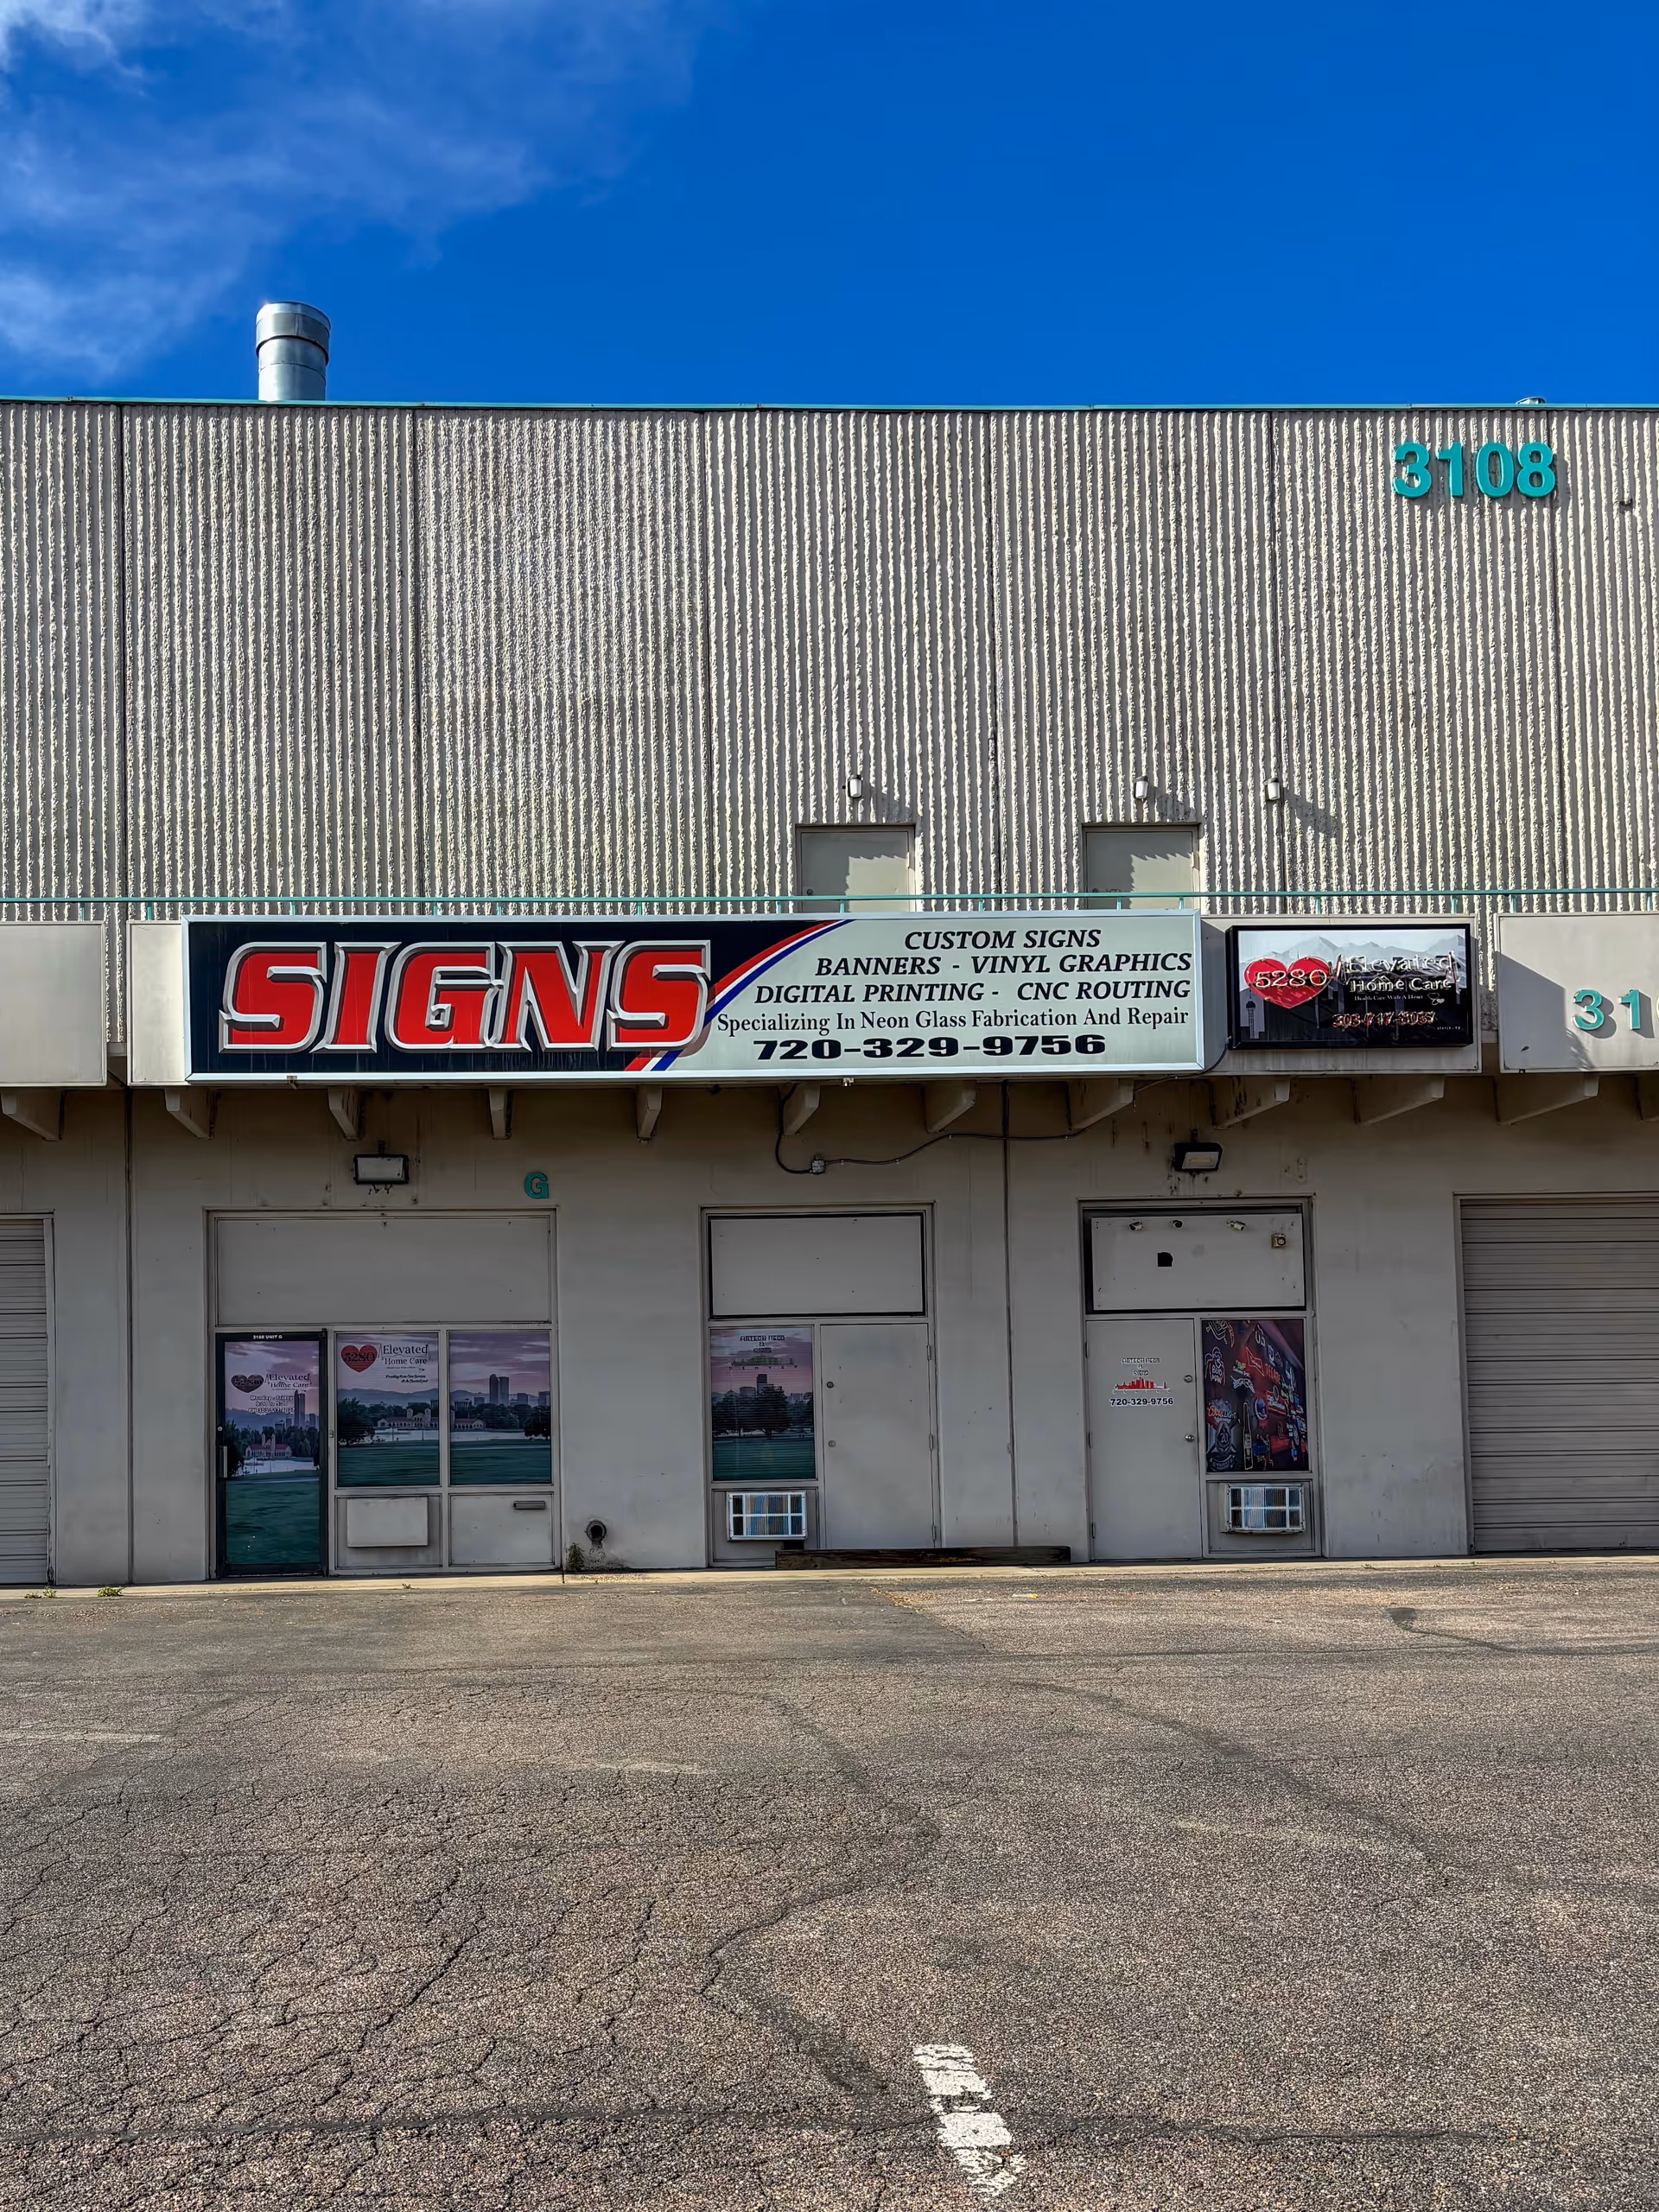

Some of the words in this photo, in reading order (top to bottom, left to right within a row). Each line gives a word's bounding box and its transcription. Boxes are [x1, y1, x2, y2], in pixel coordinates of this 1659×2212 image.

[1393, 442, 1556, 499] 3108
[905, 930, 1016, 951] CUSTOM
[1022, 928, 1102, 949] SIGNS
[816, 956, 942, 976] BANNERS
[971, 954, 1051, 975] VINYL
[1058, 952, 1192, 974] GRAPHICS
[1348, 953, 1453, 974] Elevated
[1255, 969, 1328, 988] 5280
[1350, 979, 1405, 993] Home
[1409, 977, 1452, 993] Care
[218, 939, 712, 1054] SIGNS
[754, 983, 855, 1004] DIGITAL
[862, 982, 985, 1003] PRINTING
[1016, 981, 1072, 1001] CNC
[1075, 979, 1192, 1001] ROUTING
[717, 1013, 830, 1037] Specializing
[836, 1013, 855, 1031] In
[860, 1010, 911, 1030] Neon
[915, 1009, 967, 1028] Glass
[971, 1007, 1077, 1027] Fabrication
[1083, 1007, 1122, 1027] And
[1127, 1007, 1189, 1030] Repair
[1573, 988, 1659, 1032] 31
[753, 1034, 1107, 1061] 720-329-9756
[524, 1172, 550, 1199] G
[383, 1344, 429, 1355] Elevated
[269, 1372, 311, 1381] Elevated
[1109, 1398, 1174, 1407] 720-329-9756
